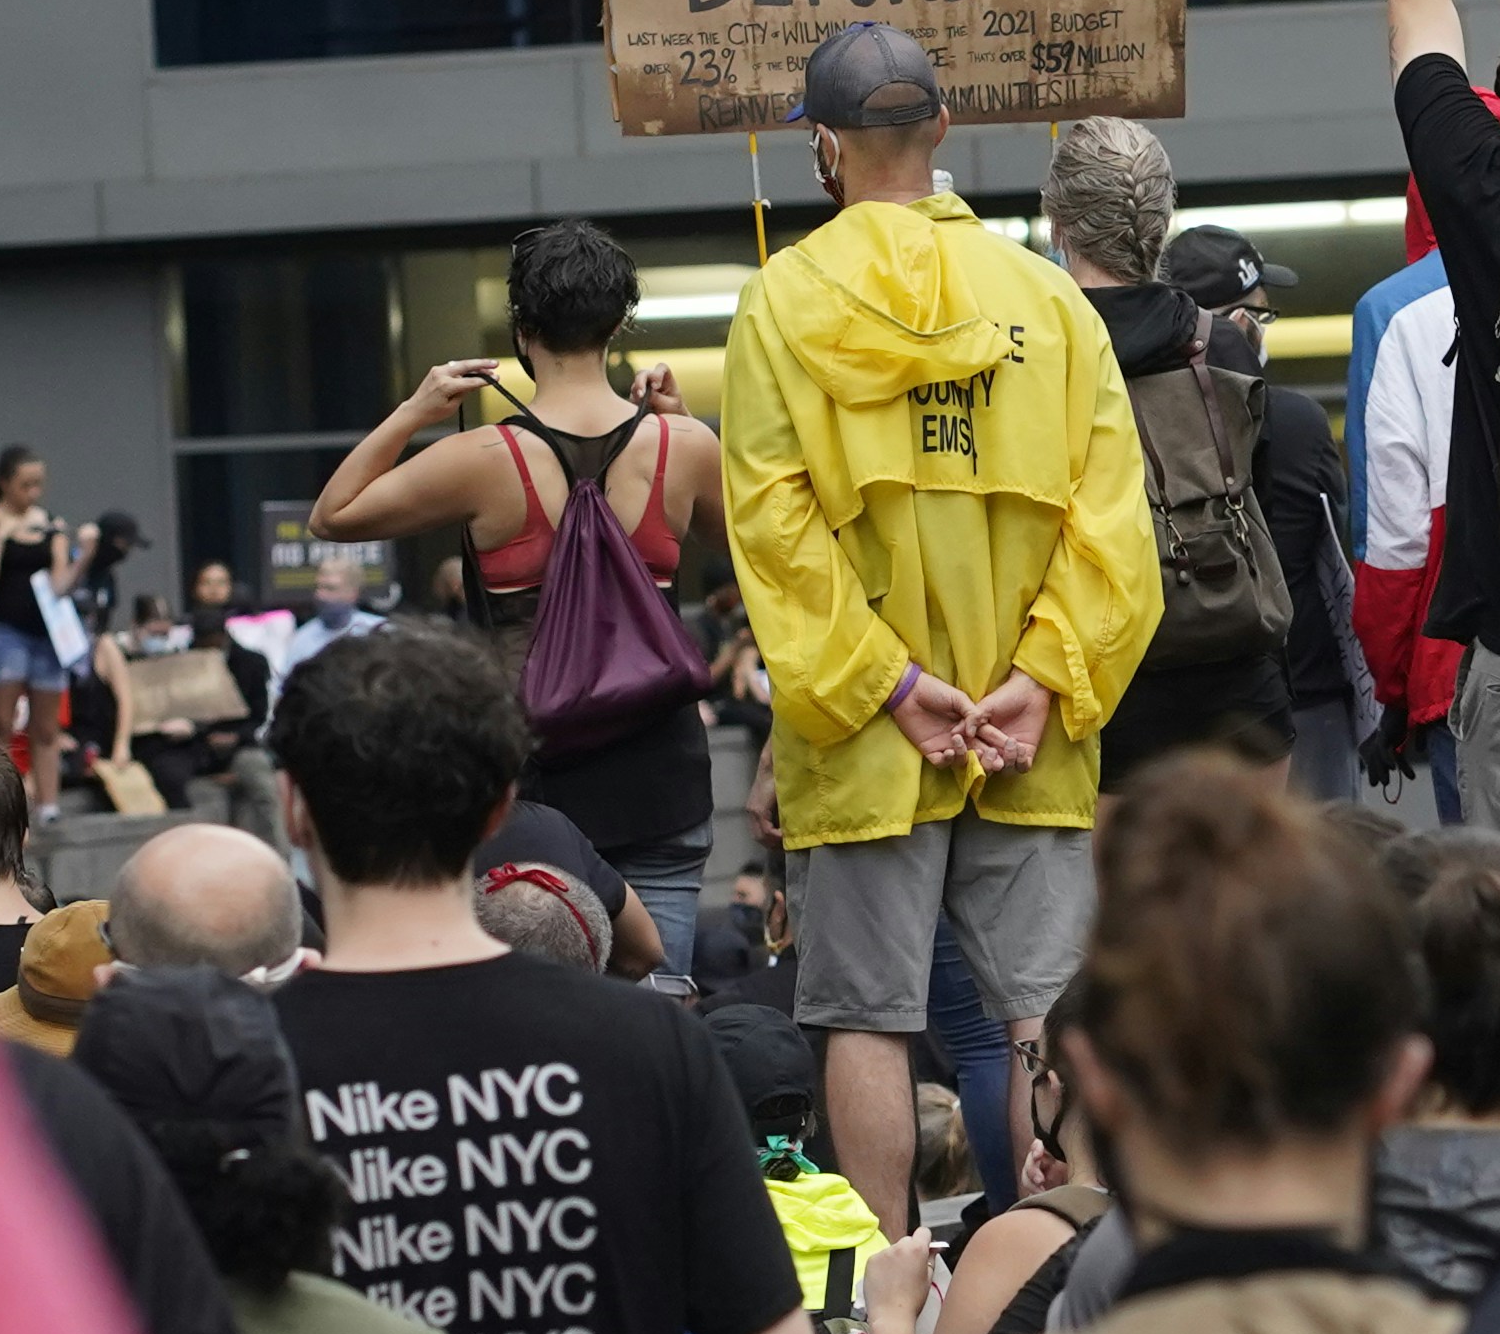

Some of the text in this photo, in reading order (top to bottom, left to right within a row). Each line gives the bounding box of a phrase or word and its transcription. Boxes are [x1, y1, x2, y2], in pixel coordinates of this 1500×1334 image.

[627, 32, 658, 46] LAST
[661, 33, 694, 46] WEEK
[698, 32, 721, 45] THE
[727, 21, 768, 46] CITY
[945, 26, 968, 39] THE
[982, 10, 1036, 37] 2021
[1051, 10, 1124, 33] BUDGET
[643, 63, 672, 75] OVER
[680, 48, 737, 87] 23%
[1000, 50, 1026, 64] OVER
[1031, 40, 1075, 74] $59
[1077, 43, 1145, 68] MILLION
[907, 369, 995, 408] OUNTY
[922, 414, 971, 456] EMS
[305, 1062, 584, 1142] Nike NYC
[457, 1128, 593, 1191] NYC
[329, 1196, 599, 1278] Nike NYC
[366, 1263, 598, 1329] ike NYC
